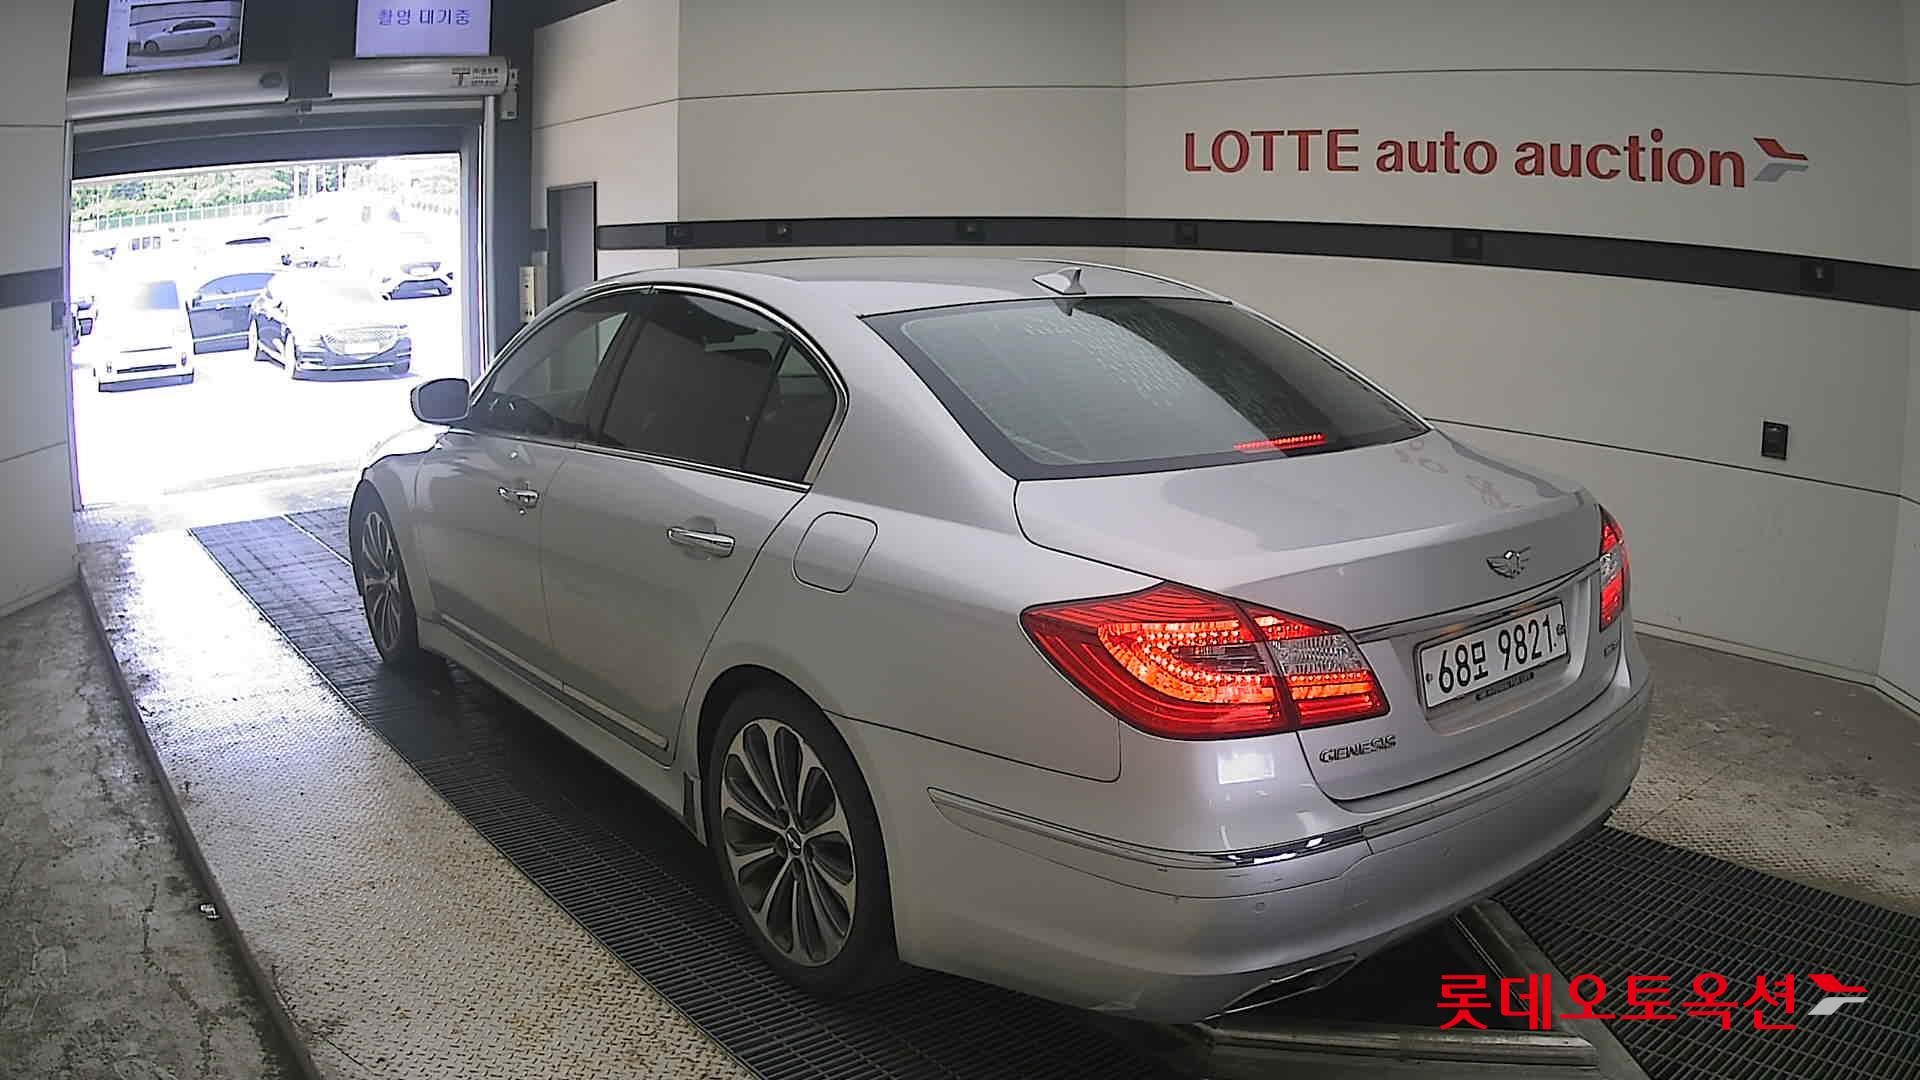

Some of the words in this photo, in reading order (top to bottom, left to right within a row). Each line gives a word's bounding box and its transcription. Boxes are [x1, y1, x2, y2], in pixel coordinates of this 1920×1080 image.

[419, 8, 471, 26] 대기중
[1184, 128, 1360, 173] LOTTE
[1376, 130, 1498, 175] auto
[1514, 128, 1745, 189] auction
[1438, 640, 1489, 694] 68모
[1498, 614, 1553, 671] 9821
[1319, 734, 1397, 763] GENESIS
